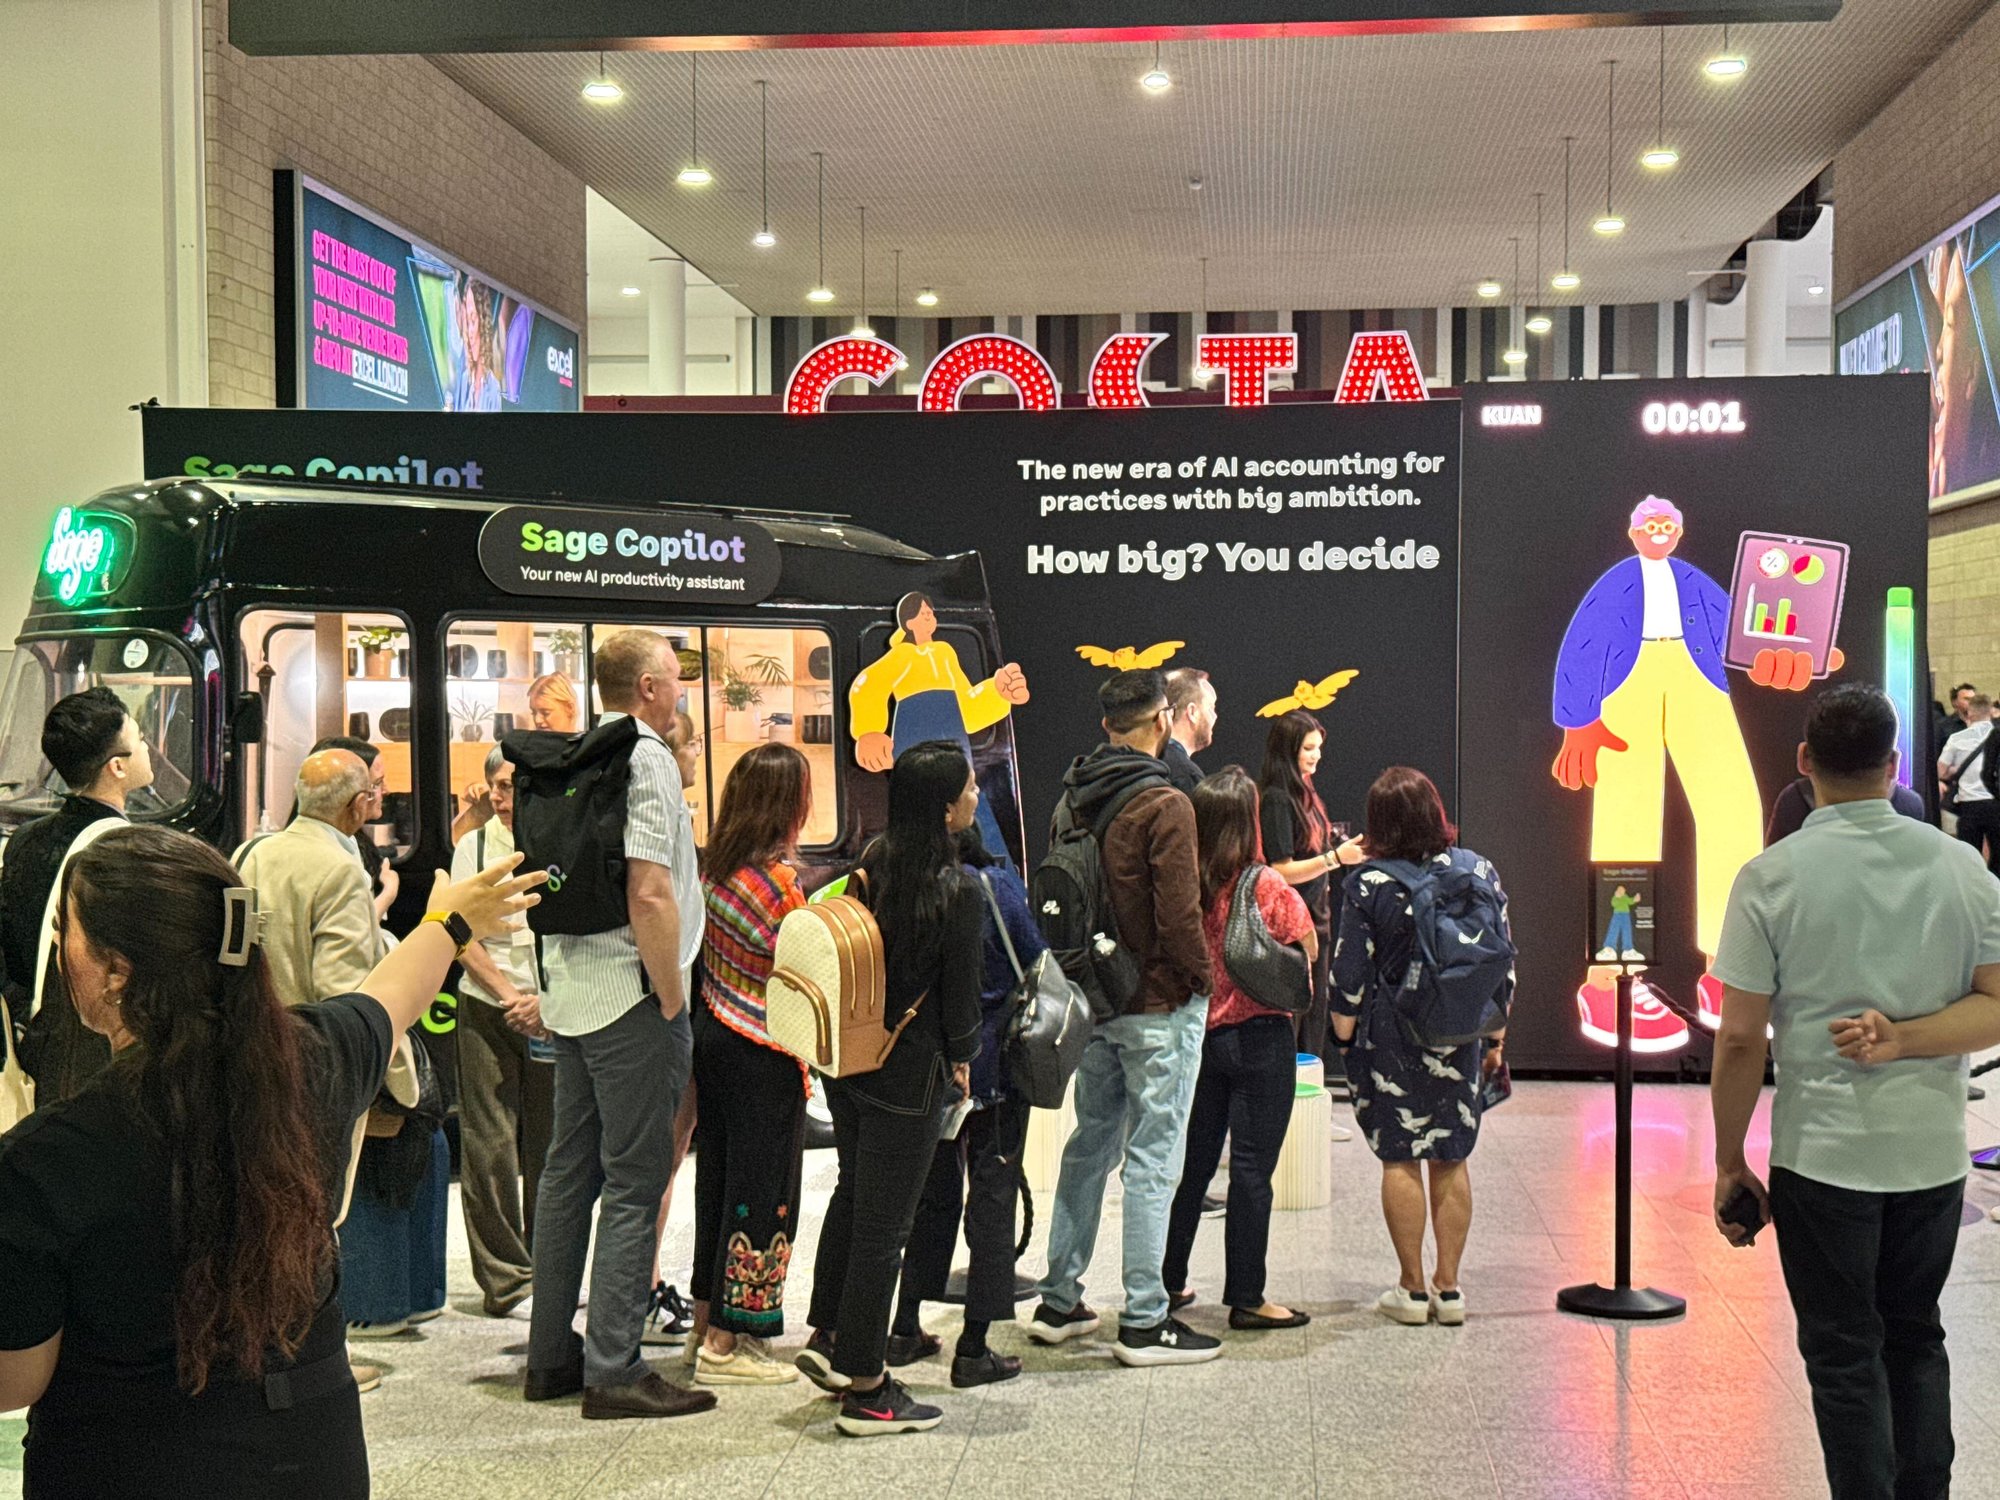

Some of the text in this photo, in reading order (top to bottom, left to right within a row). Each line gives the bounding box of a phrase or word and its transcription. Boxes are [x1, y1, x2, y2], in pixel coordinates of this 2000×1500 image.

[313, 229, 328, 264] GET
[331, 239, 346, 272] THE
[348, 247, 368, 283] MOST
[369, 258, 384, 290] OUT
[313, 265, 336, 302] YOUR
[1481, 404, 1542, 426] KUAN
[1641, 400, 1746, 434] 00:01
[184, 456, 295, 478] Sa
[1017, 451, 1445, 480] The new era of AI accounting for
[1040, 484, 1421, 517] practices with big ambition.
[520, 522, 746, 566] Sage Copilot
[1027, 536, 1440, 581] How big? You decide
[520, 565, 746, 591] Your new AI productivity assistant
